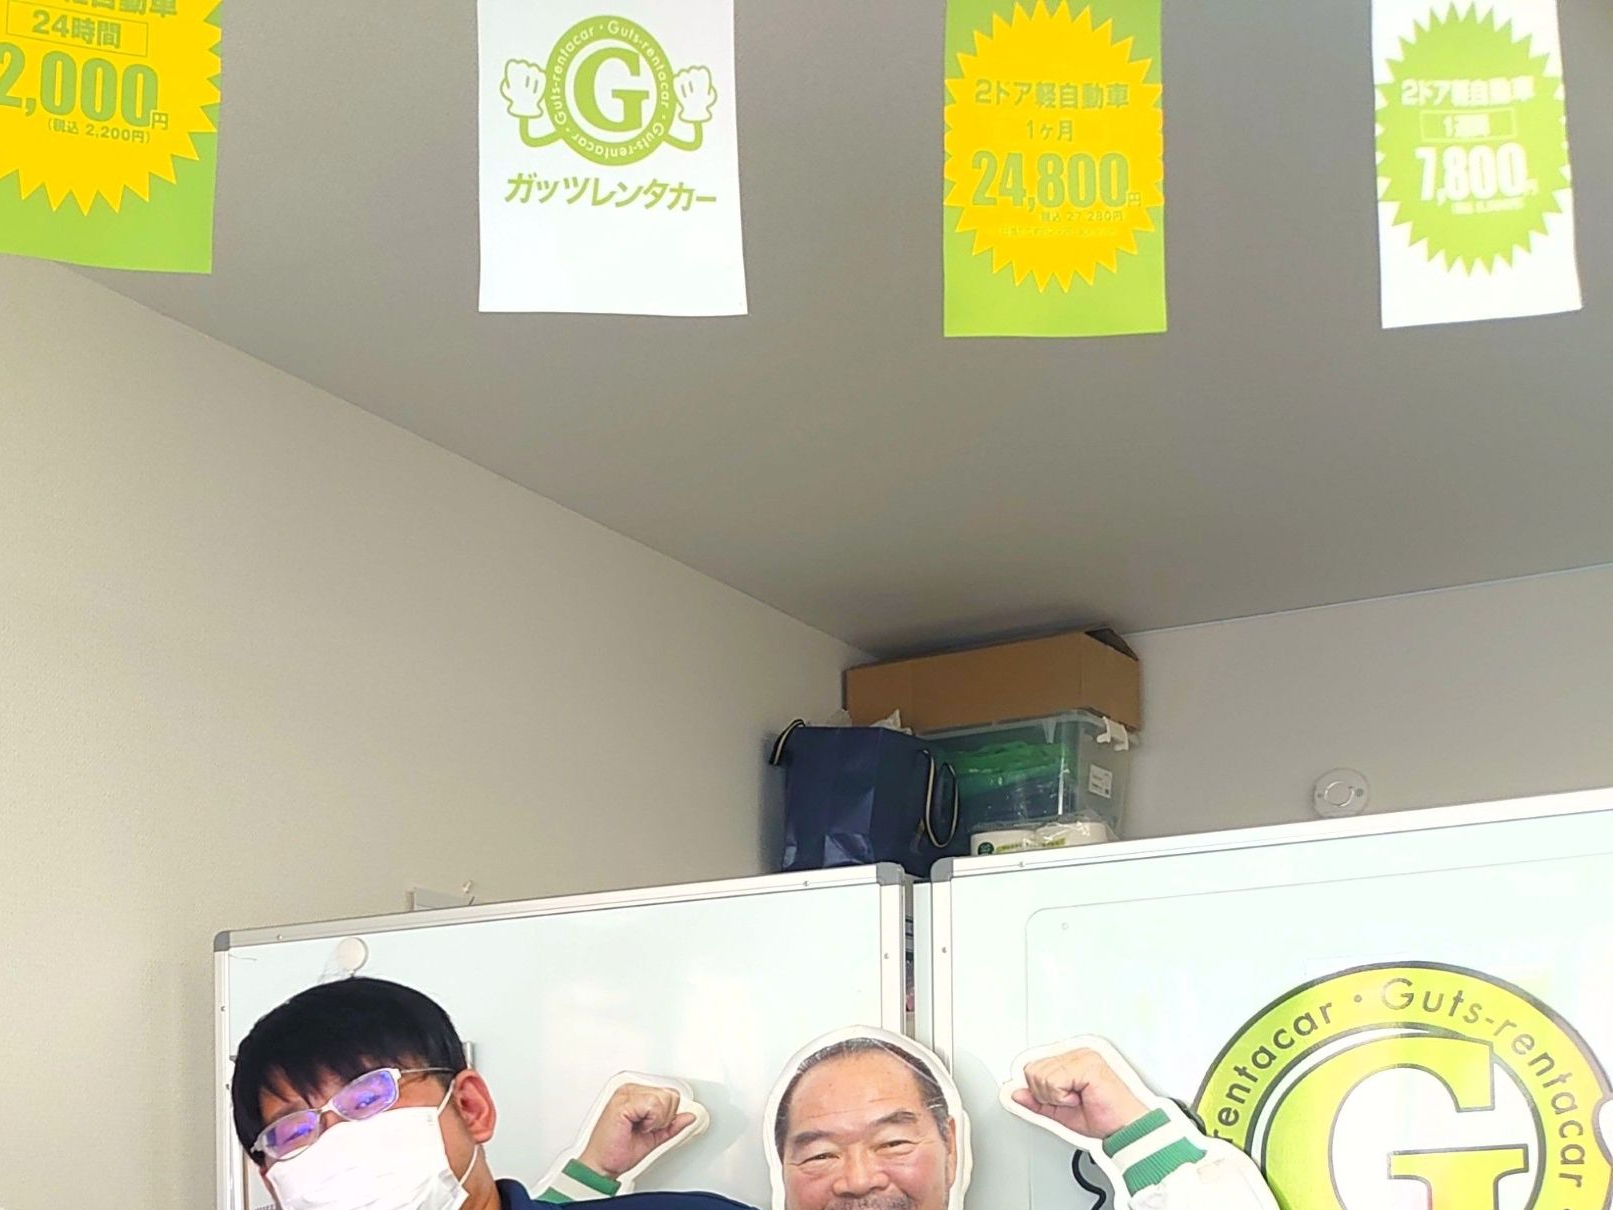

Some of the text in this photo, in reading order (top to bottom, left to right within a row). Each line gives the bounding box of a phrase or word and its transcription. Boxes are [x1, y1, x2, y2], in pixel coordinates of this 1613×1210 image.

[32, 9, 122, 49] 24時間
[573, 46, 650, 132] G
[974, 78, 1130, 110] 2ドア軽自動車
[1025, 119, 1074, 142] 1ヶ月
[504, 172, 718, 212] ガッツレンタカー
[971, 150, 1142, 213] 24,800円
[1379, 976, 1587, 1190] Guts-rentacar
